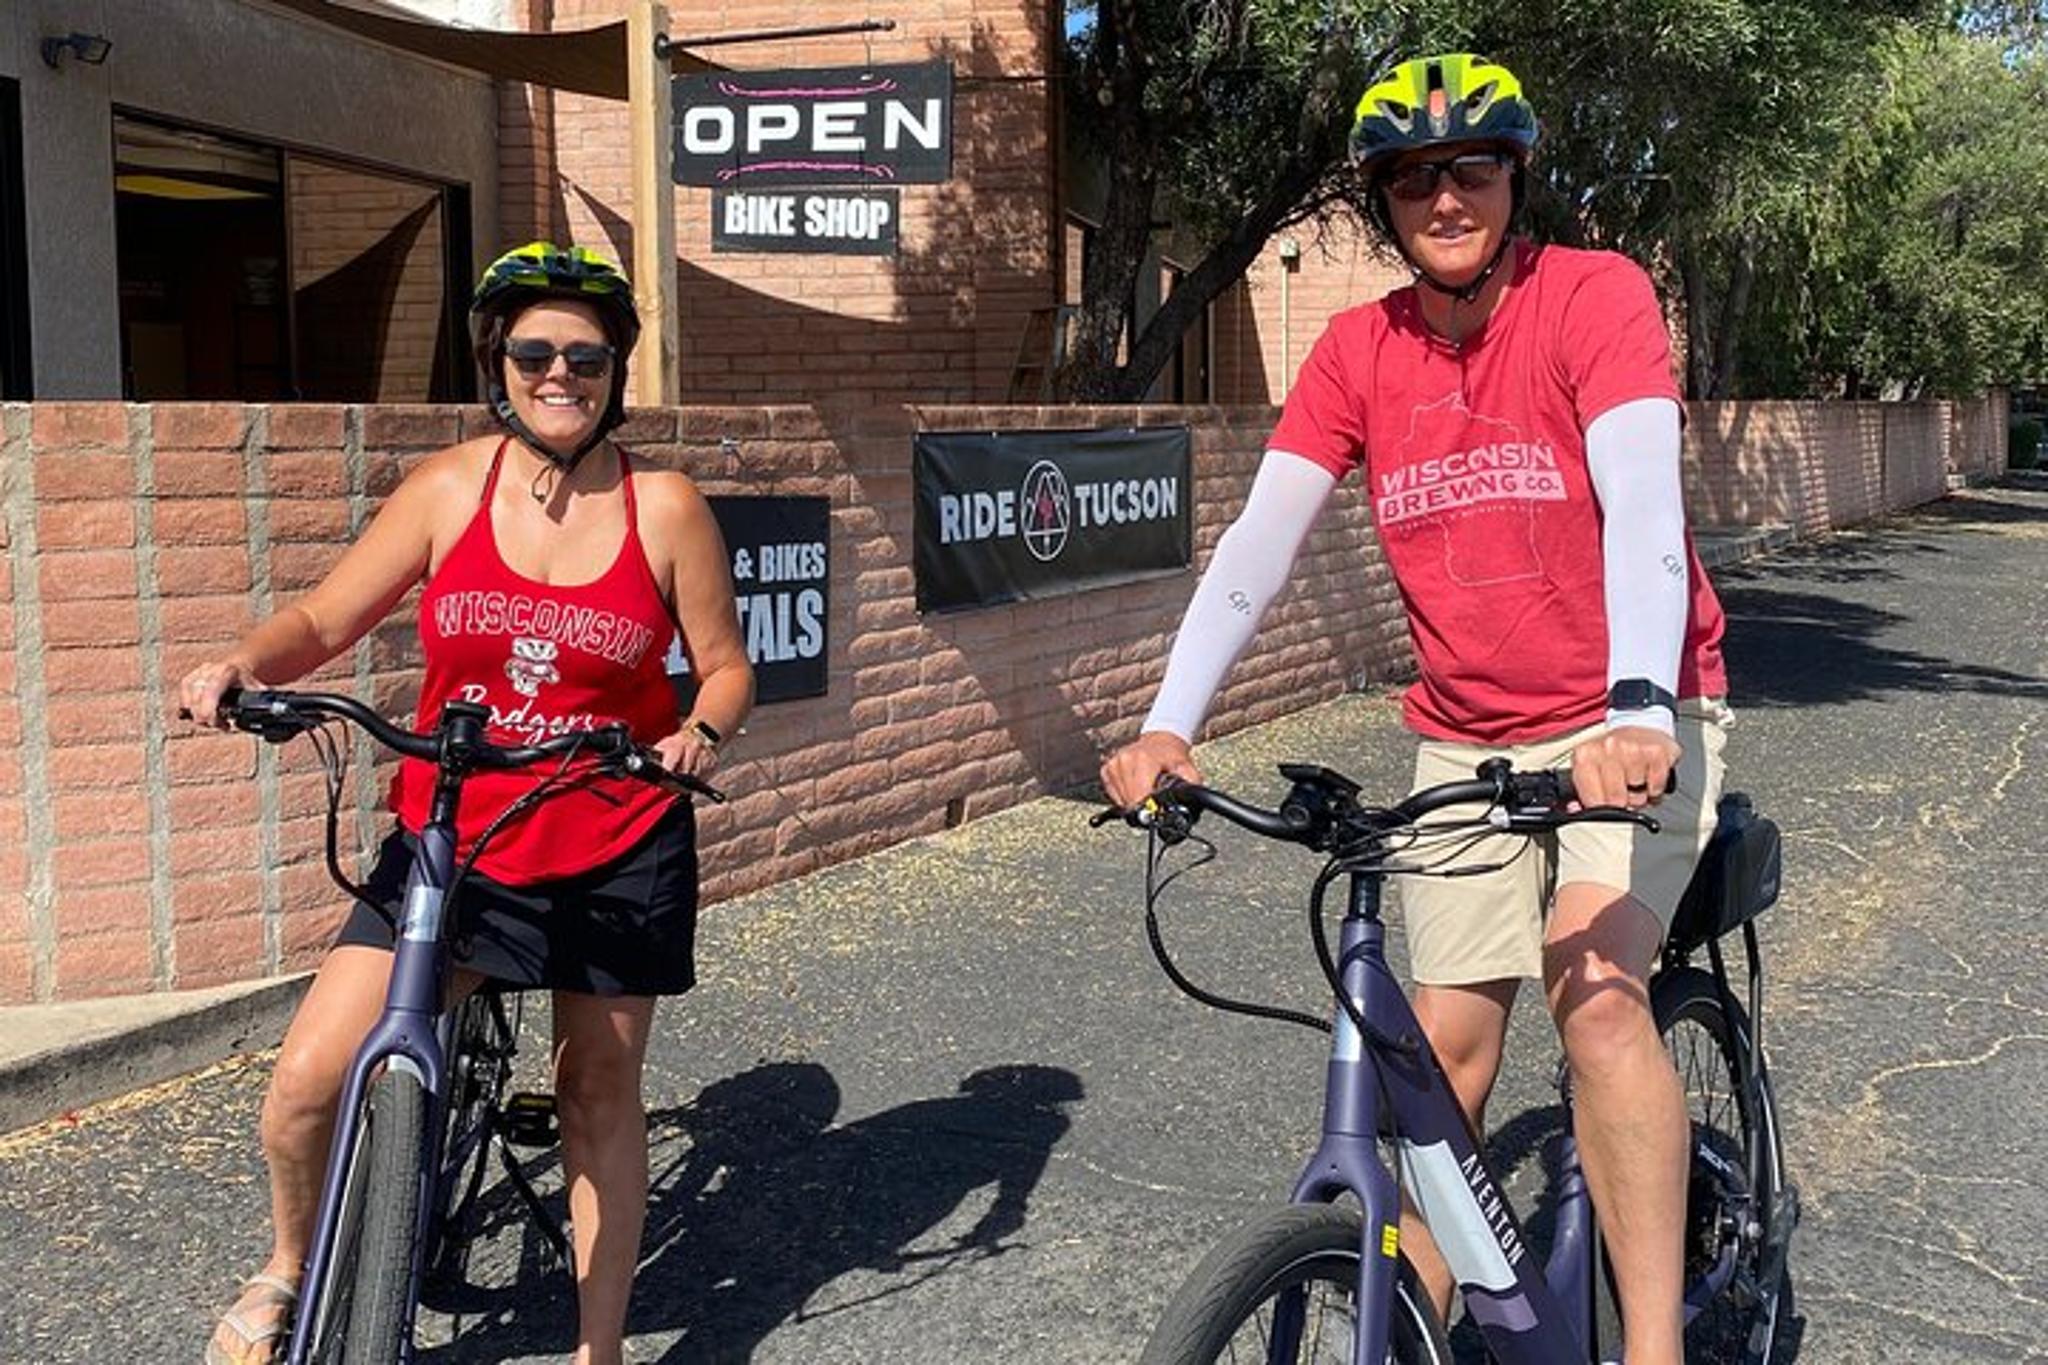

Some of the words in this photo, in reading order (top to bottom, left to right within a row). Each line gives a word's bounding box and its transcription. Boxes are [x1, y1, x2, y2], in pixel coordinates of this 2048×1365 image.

[683, 98, 942, 154] OPEN
[724, 195, 796, 236] BIKE
[804, 195, 890, 240] SHOP
[1381, 441, 1557, 495] WISCONSIN
[939, 490, 1017, 544] RIDE
[1074, 477, 1178, 527] TUCSON
[1383, 473, 1518, 519] BREWNG
[733, 547, 754, 579] &
[758, 541, 827, 583] BIKES
[435, 591, 654, 669] WISCONSIN
[1461, 1153, 1526, 1265] AVENTON
